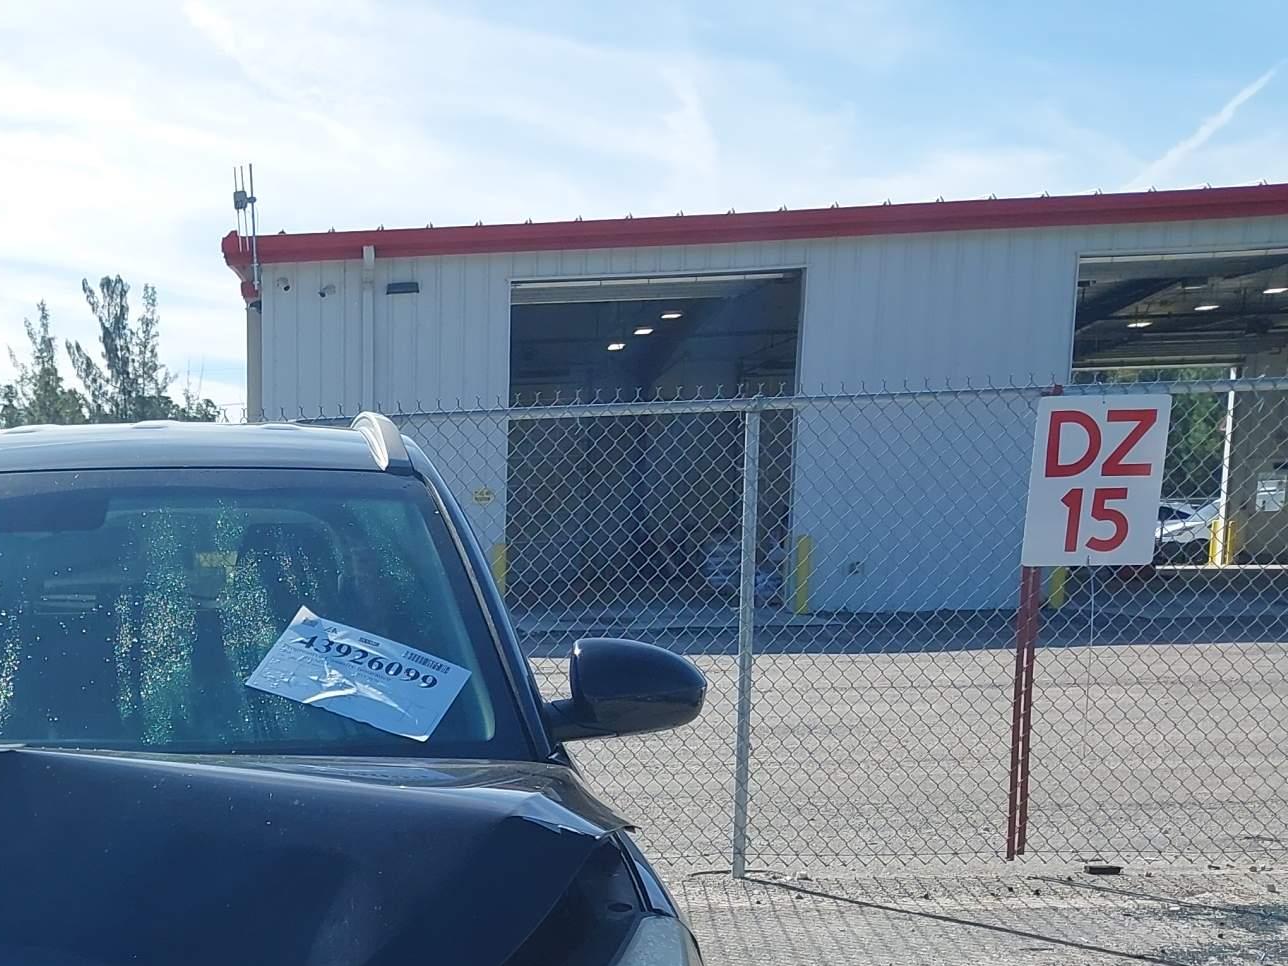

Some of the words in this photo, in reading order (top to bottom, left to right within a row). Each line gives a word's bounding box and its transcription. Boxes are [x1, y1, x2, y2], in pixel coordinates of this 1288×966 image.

[1045, 409, 1158, 478] DZ
[1060, 488, 1129, 552] 15
[291, 635, 438, 689] 43926099
